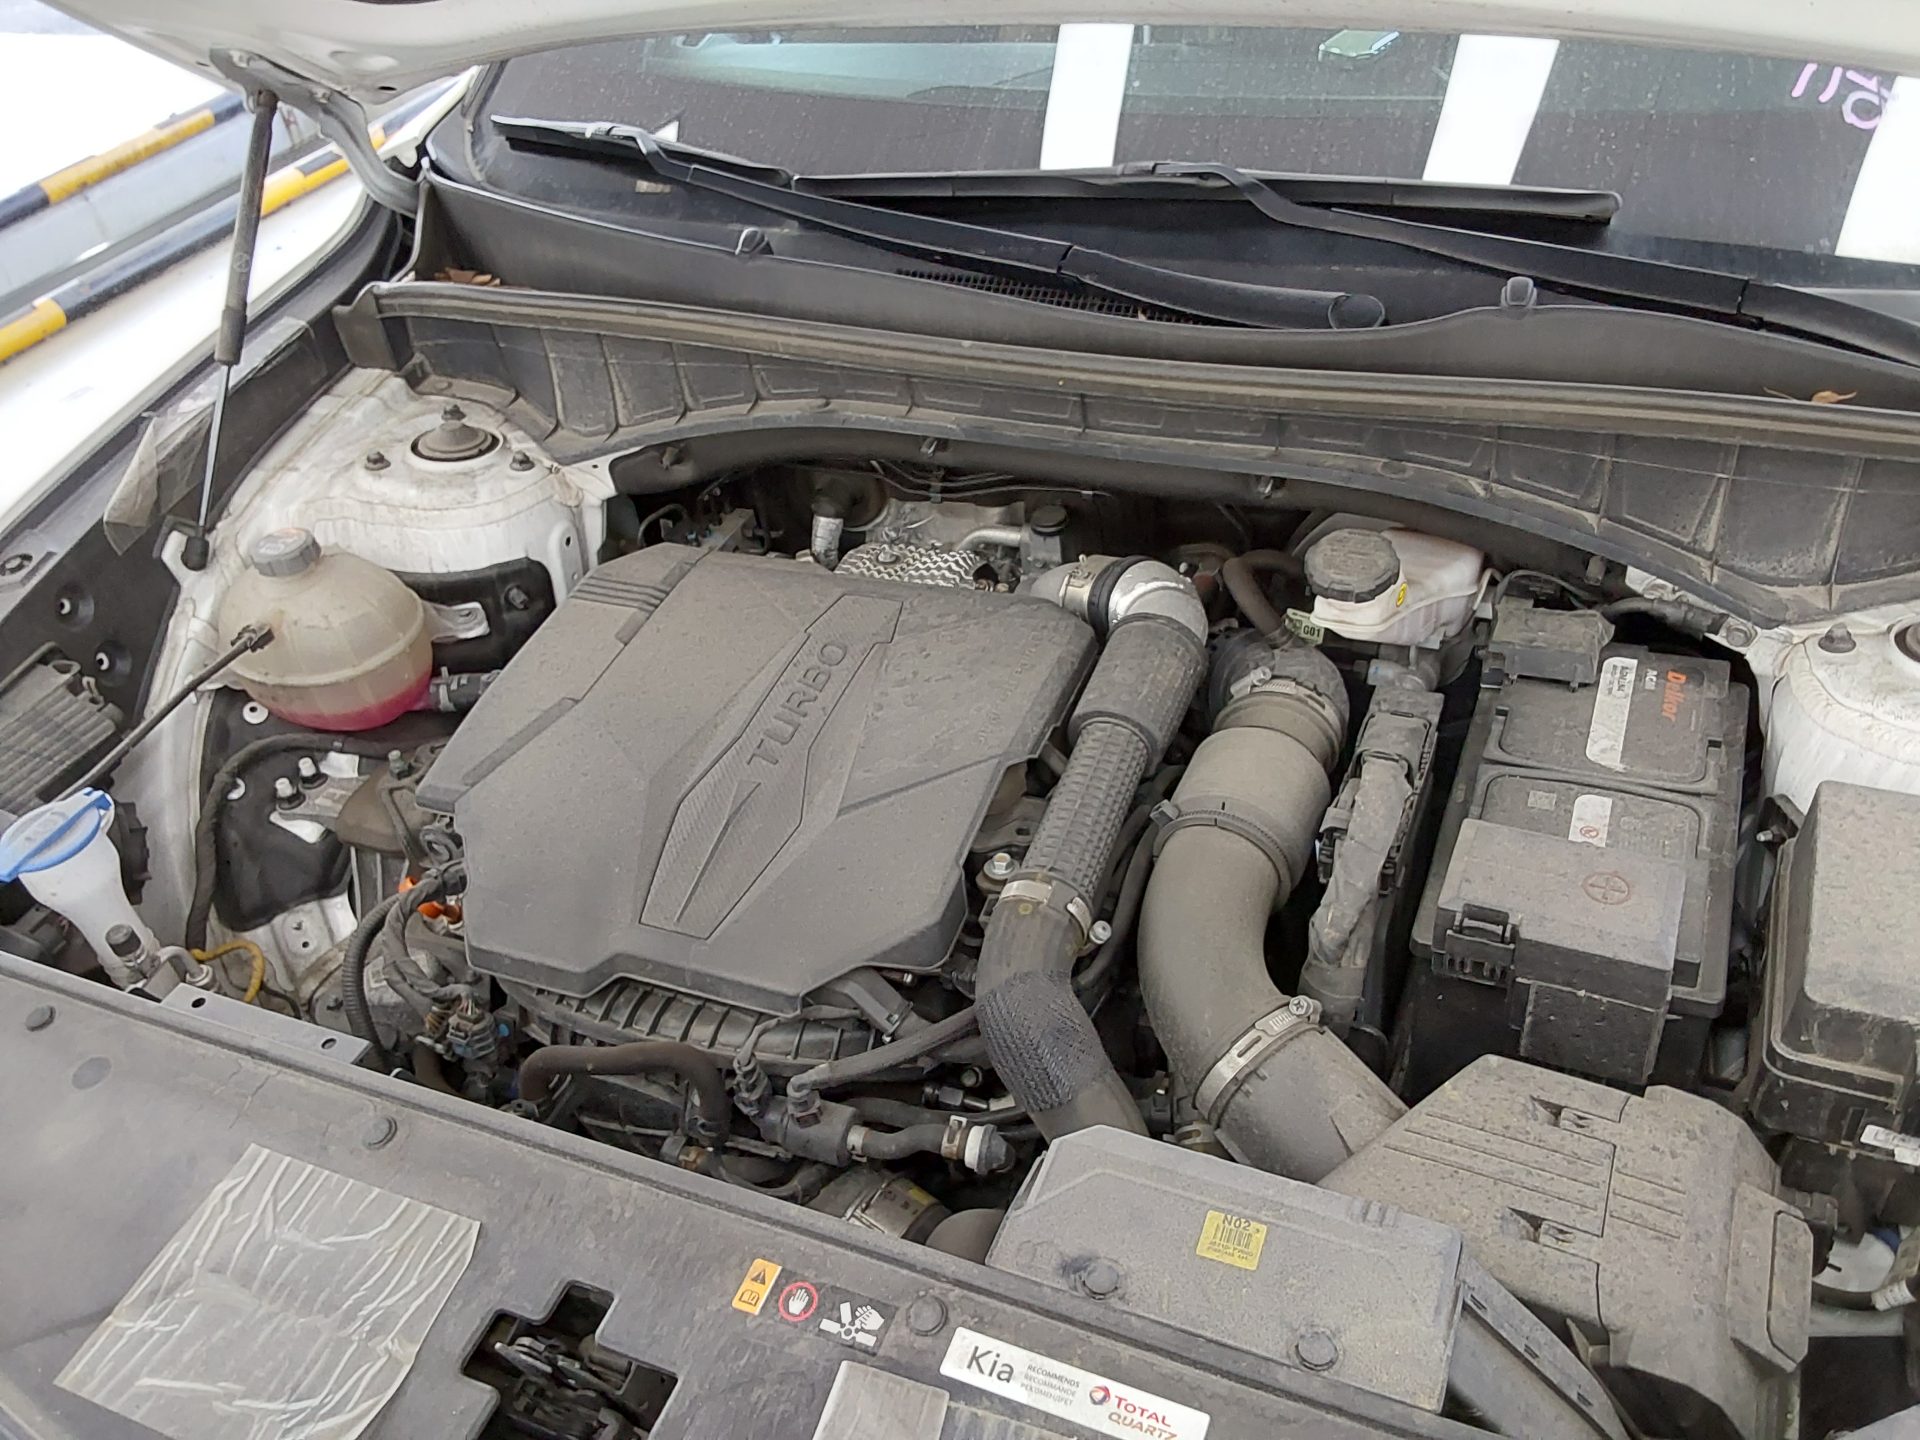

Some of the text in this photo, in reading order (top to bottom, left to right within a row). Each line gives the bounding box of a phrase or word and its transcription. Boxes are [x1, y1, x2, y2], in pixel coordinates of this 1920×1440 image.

[1303, 625, 1321, 638] G01
[746, 642, 848, 766] TURBO
[1222, 1213, 1252, 1232] N02
[966, 1346, 1015, 1384] Kia
[1027, 1364, 1080, 1389] RECOMMENDS
[1107, 1411, 1178, 1440] QUARTZ
[1114, 1394, 1172, 1428] TOTAL
